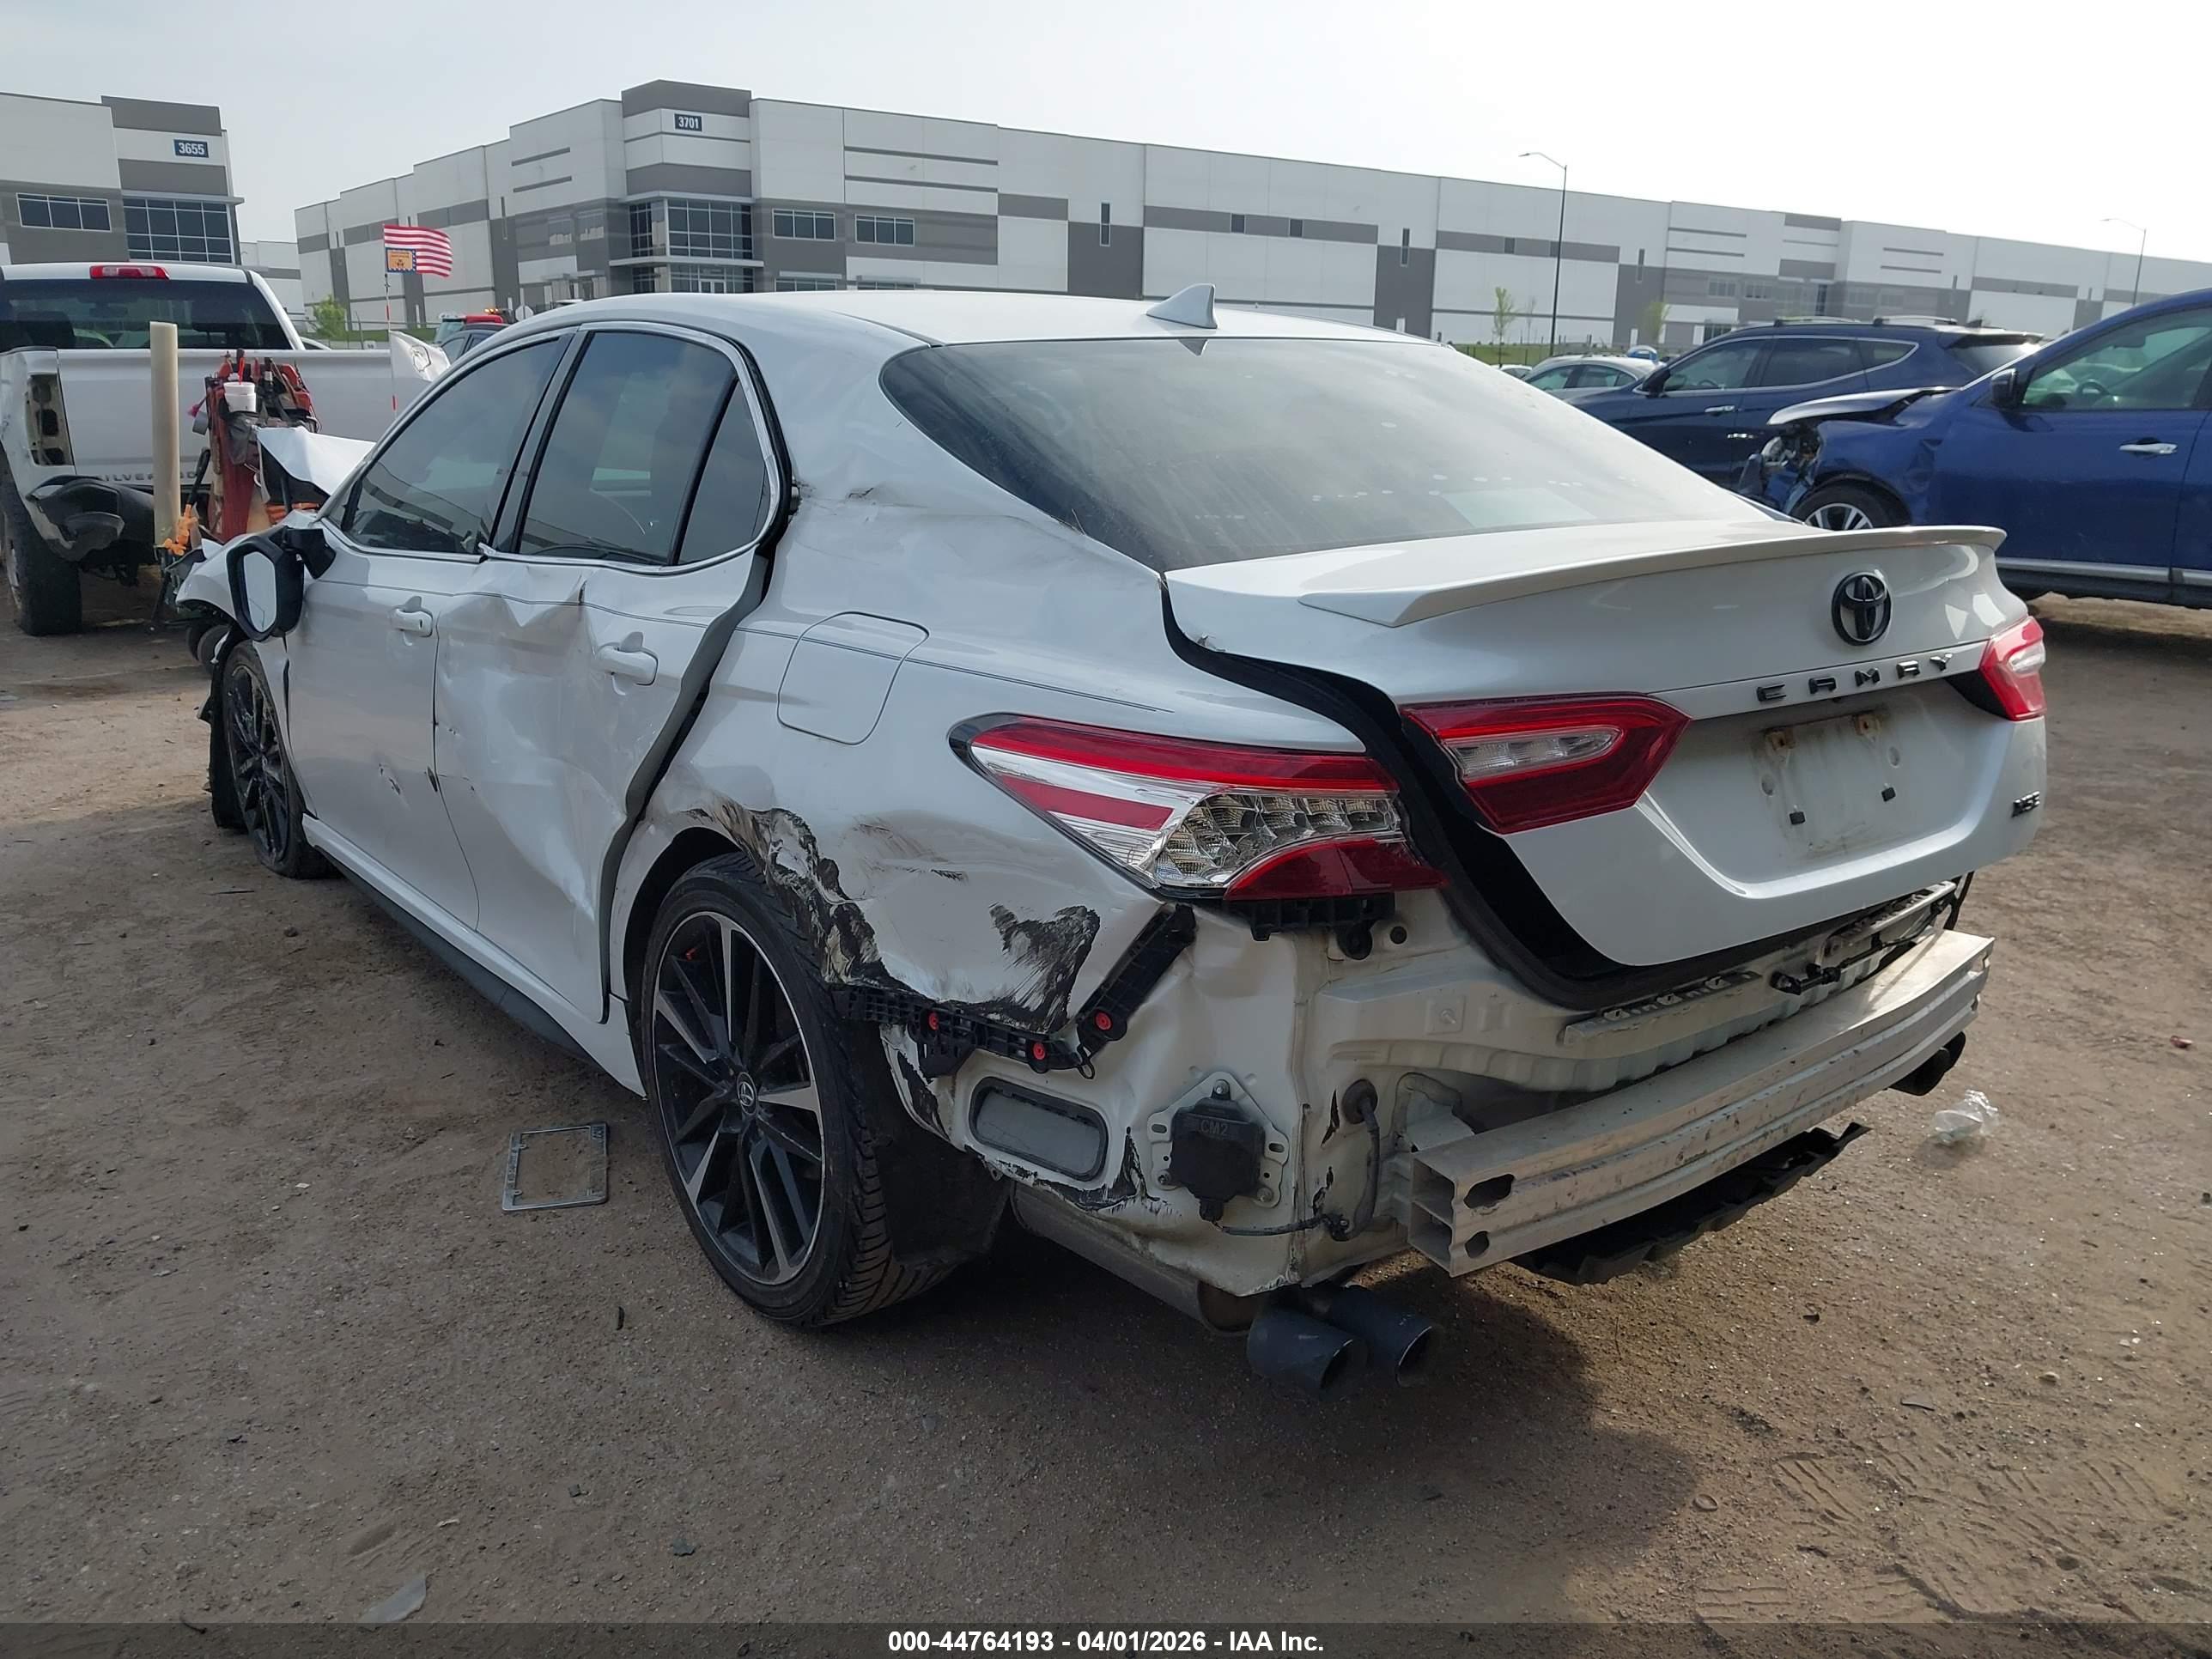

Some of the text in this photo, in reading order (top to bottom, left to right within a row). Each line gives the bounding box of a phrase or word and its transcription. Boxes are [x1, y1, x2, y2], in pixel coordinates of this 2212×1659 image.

[678, 116, 699, 129] 3701
[178, 142, 205, 155] 3655
[1756, 653, 1954, 702] CAMRY
